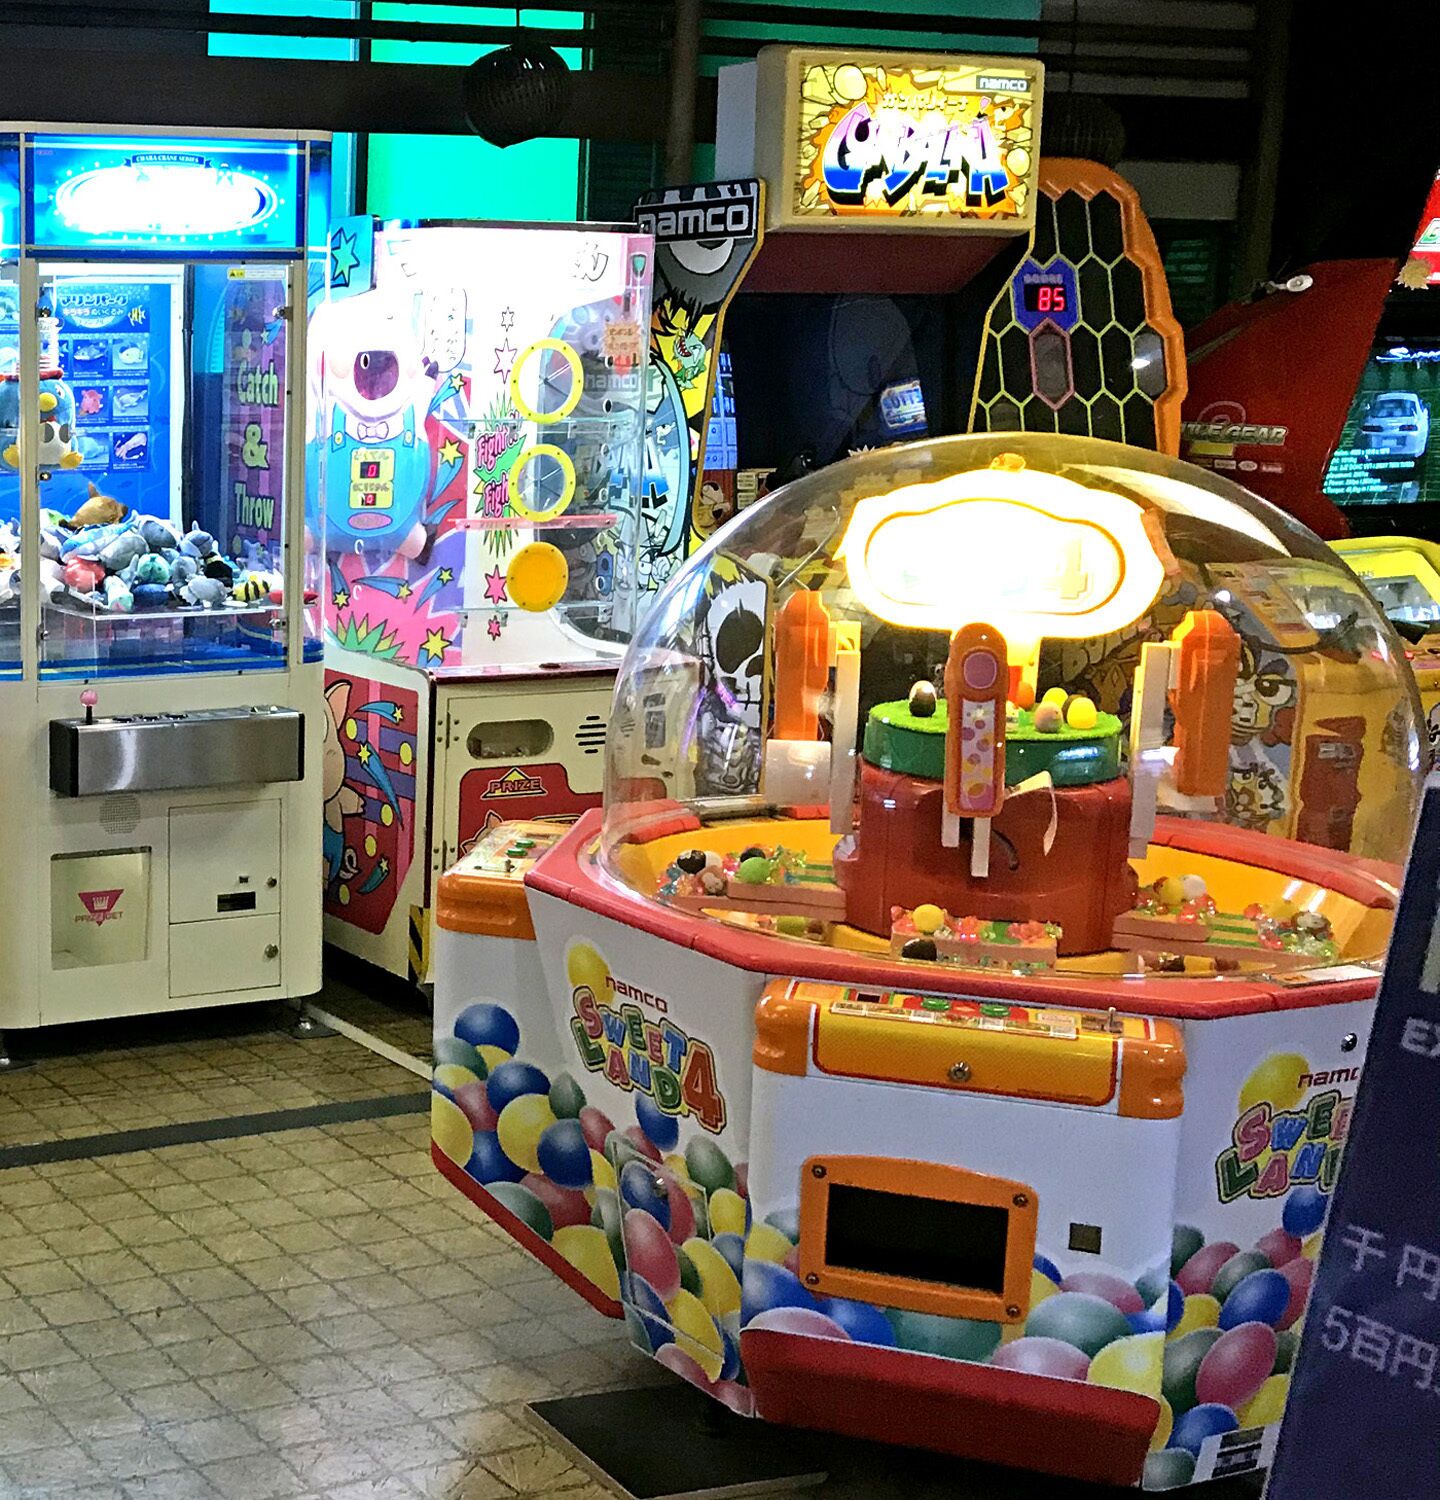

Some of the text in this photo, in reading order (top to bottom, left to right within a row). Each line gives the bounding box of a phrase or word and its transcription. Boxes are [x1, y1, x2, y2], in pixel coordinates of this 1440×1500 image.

[979, 77, 1028, 91] namco
[638, 204, 750, 237] namco
[1038, 287, 1066, 312] 85
[237, 359, 279, 407] Catch
[241, 422, 269, 469] &
[1224, 425, 1288, 444] GEAR
[367, 464, 377, 478] 0
[234, 481, 275, 528] Throw
[484, 472, 510, 518] Figh
[491, 779, 541, 793] PRIZE
[605, 975, 669, 1014] namco
[573, 986, 688, 1075] SWEET
[571, 1017, 726, 1135] LAND 4
[1297, 1067, 1359, 1089] namc
[1233, 1090, 1356, 1163] SWEE
[1321, 1305, 1438, 1389] 5百円
